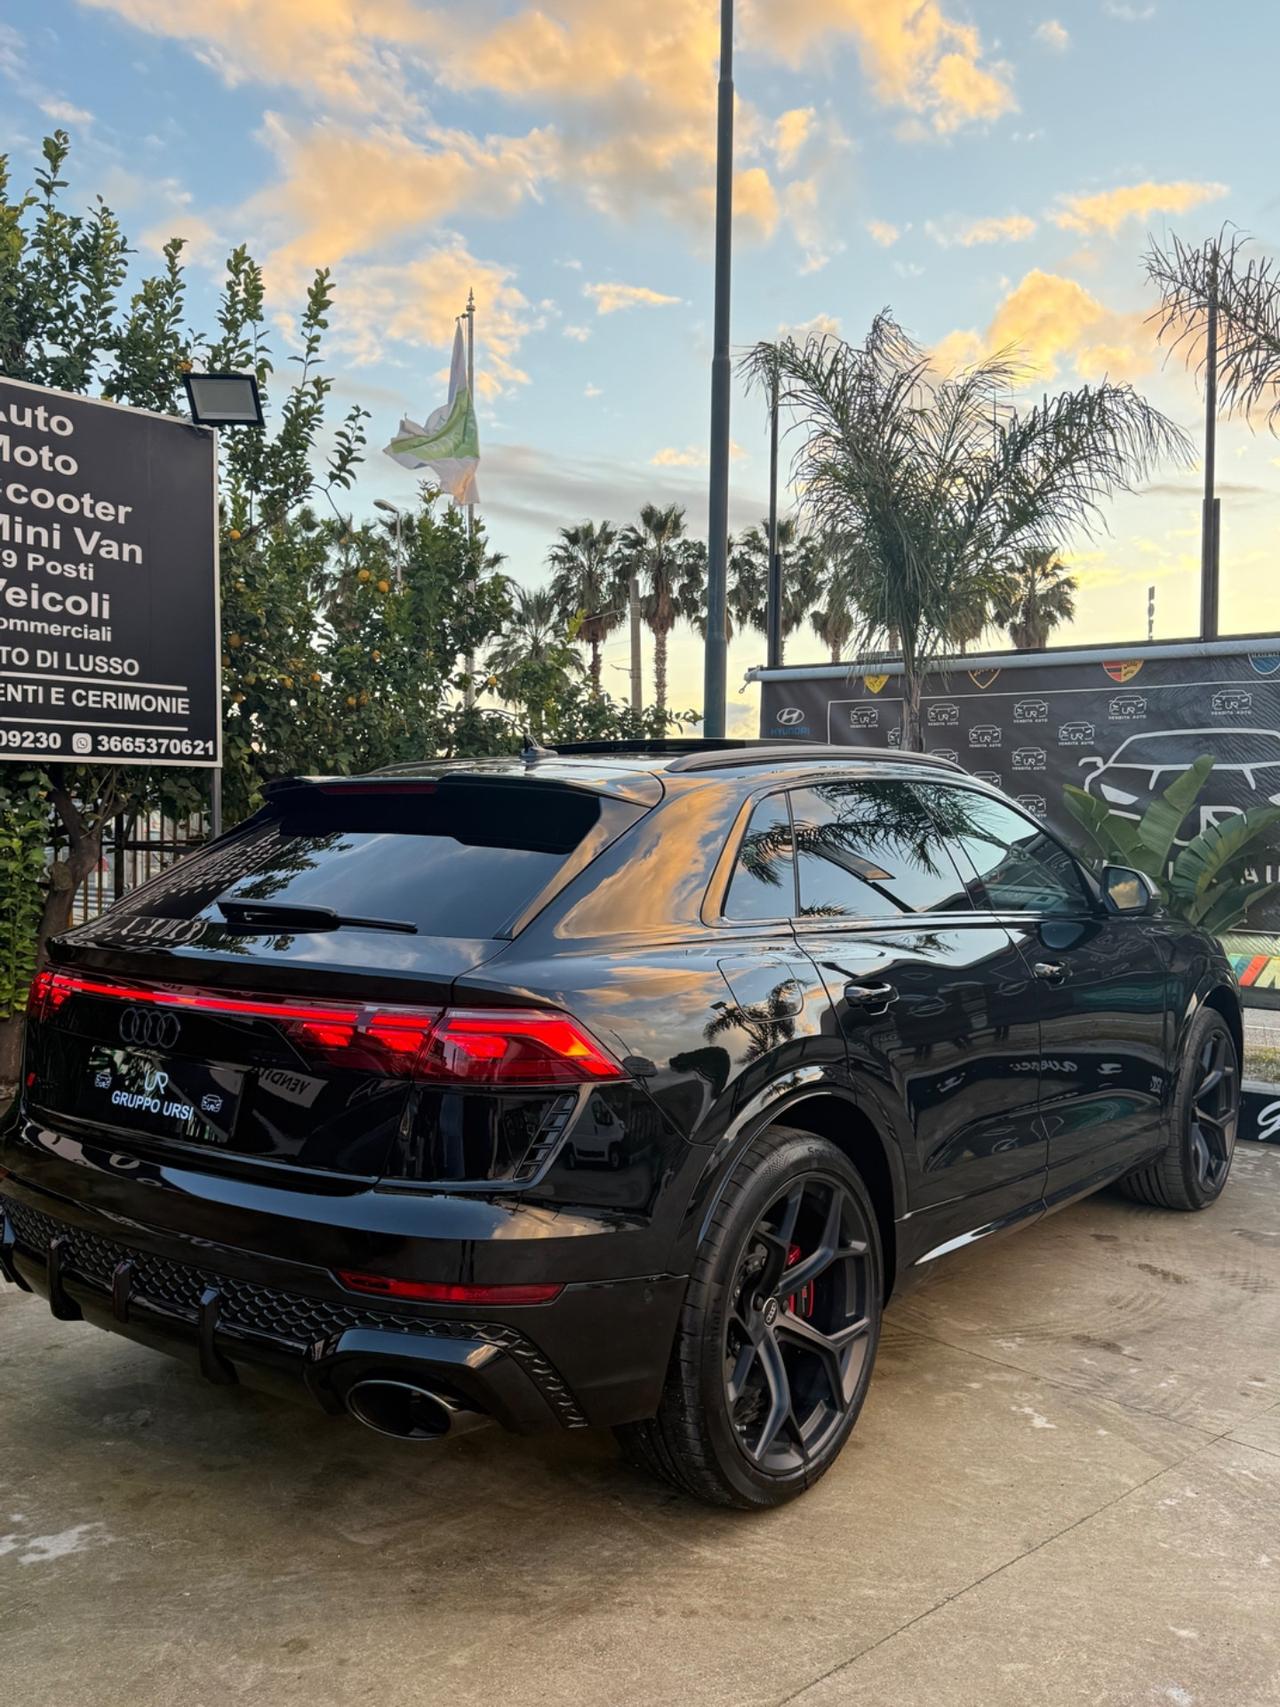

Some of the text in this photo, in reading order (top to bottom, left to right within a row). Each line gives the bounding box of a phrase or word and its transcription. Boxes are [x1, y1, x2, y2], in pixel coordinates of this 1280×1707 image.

[0, 482, 133, 524] cooter
[74, 527, 143, 564] Van
[27, 553, 94, 581] Posti
[36, 649, 58, 669] DI
[65, 652, 139, 676] LUSSO
[51, 687, 65, 705] E
[71, 689, 190, 715] CERIMONIE
[97, 735, 214, 755] 3665370621
[144, 1069, 169, 1095] UR
[111, 1090, 194, 1121] GRUPPO URSI
